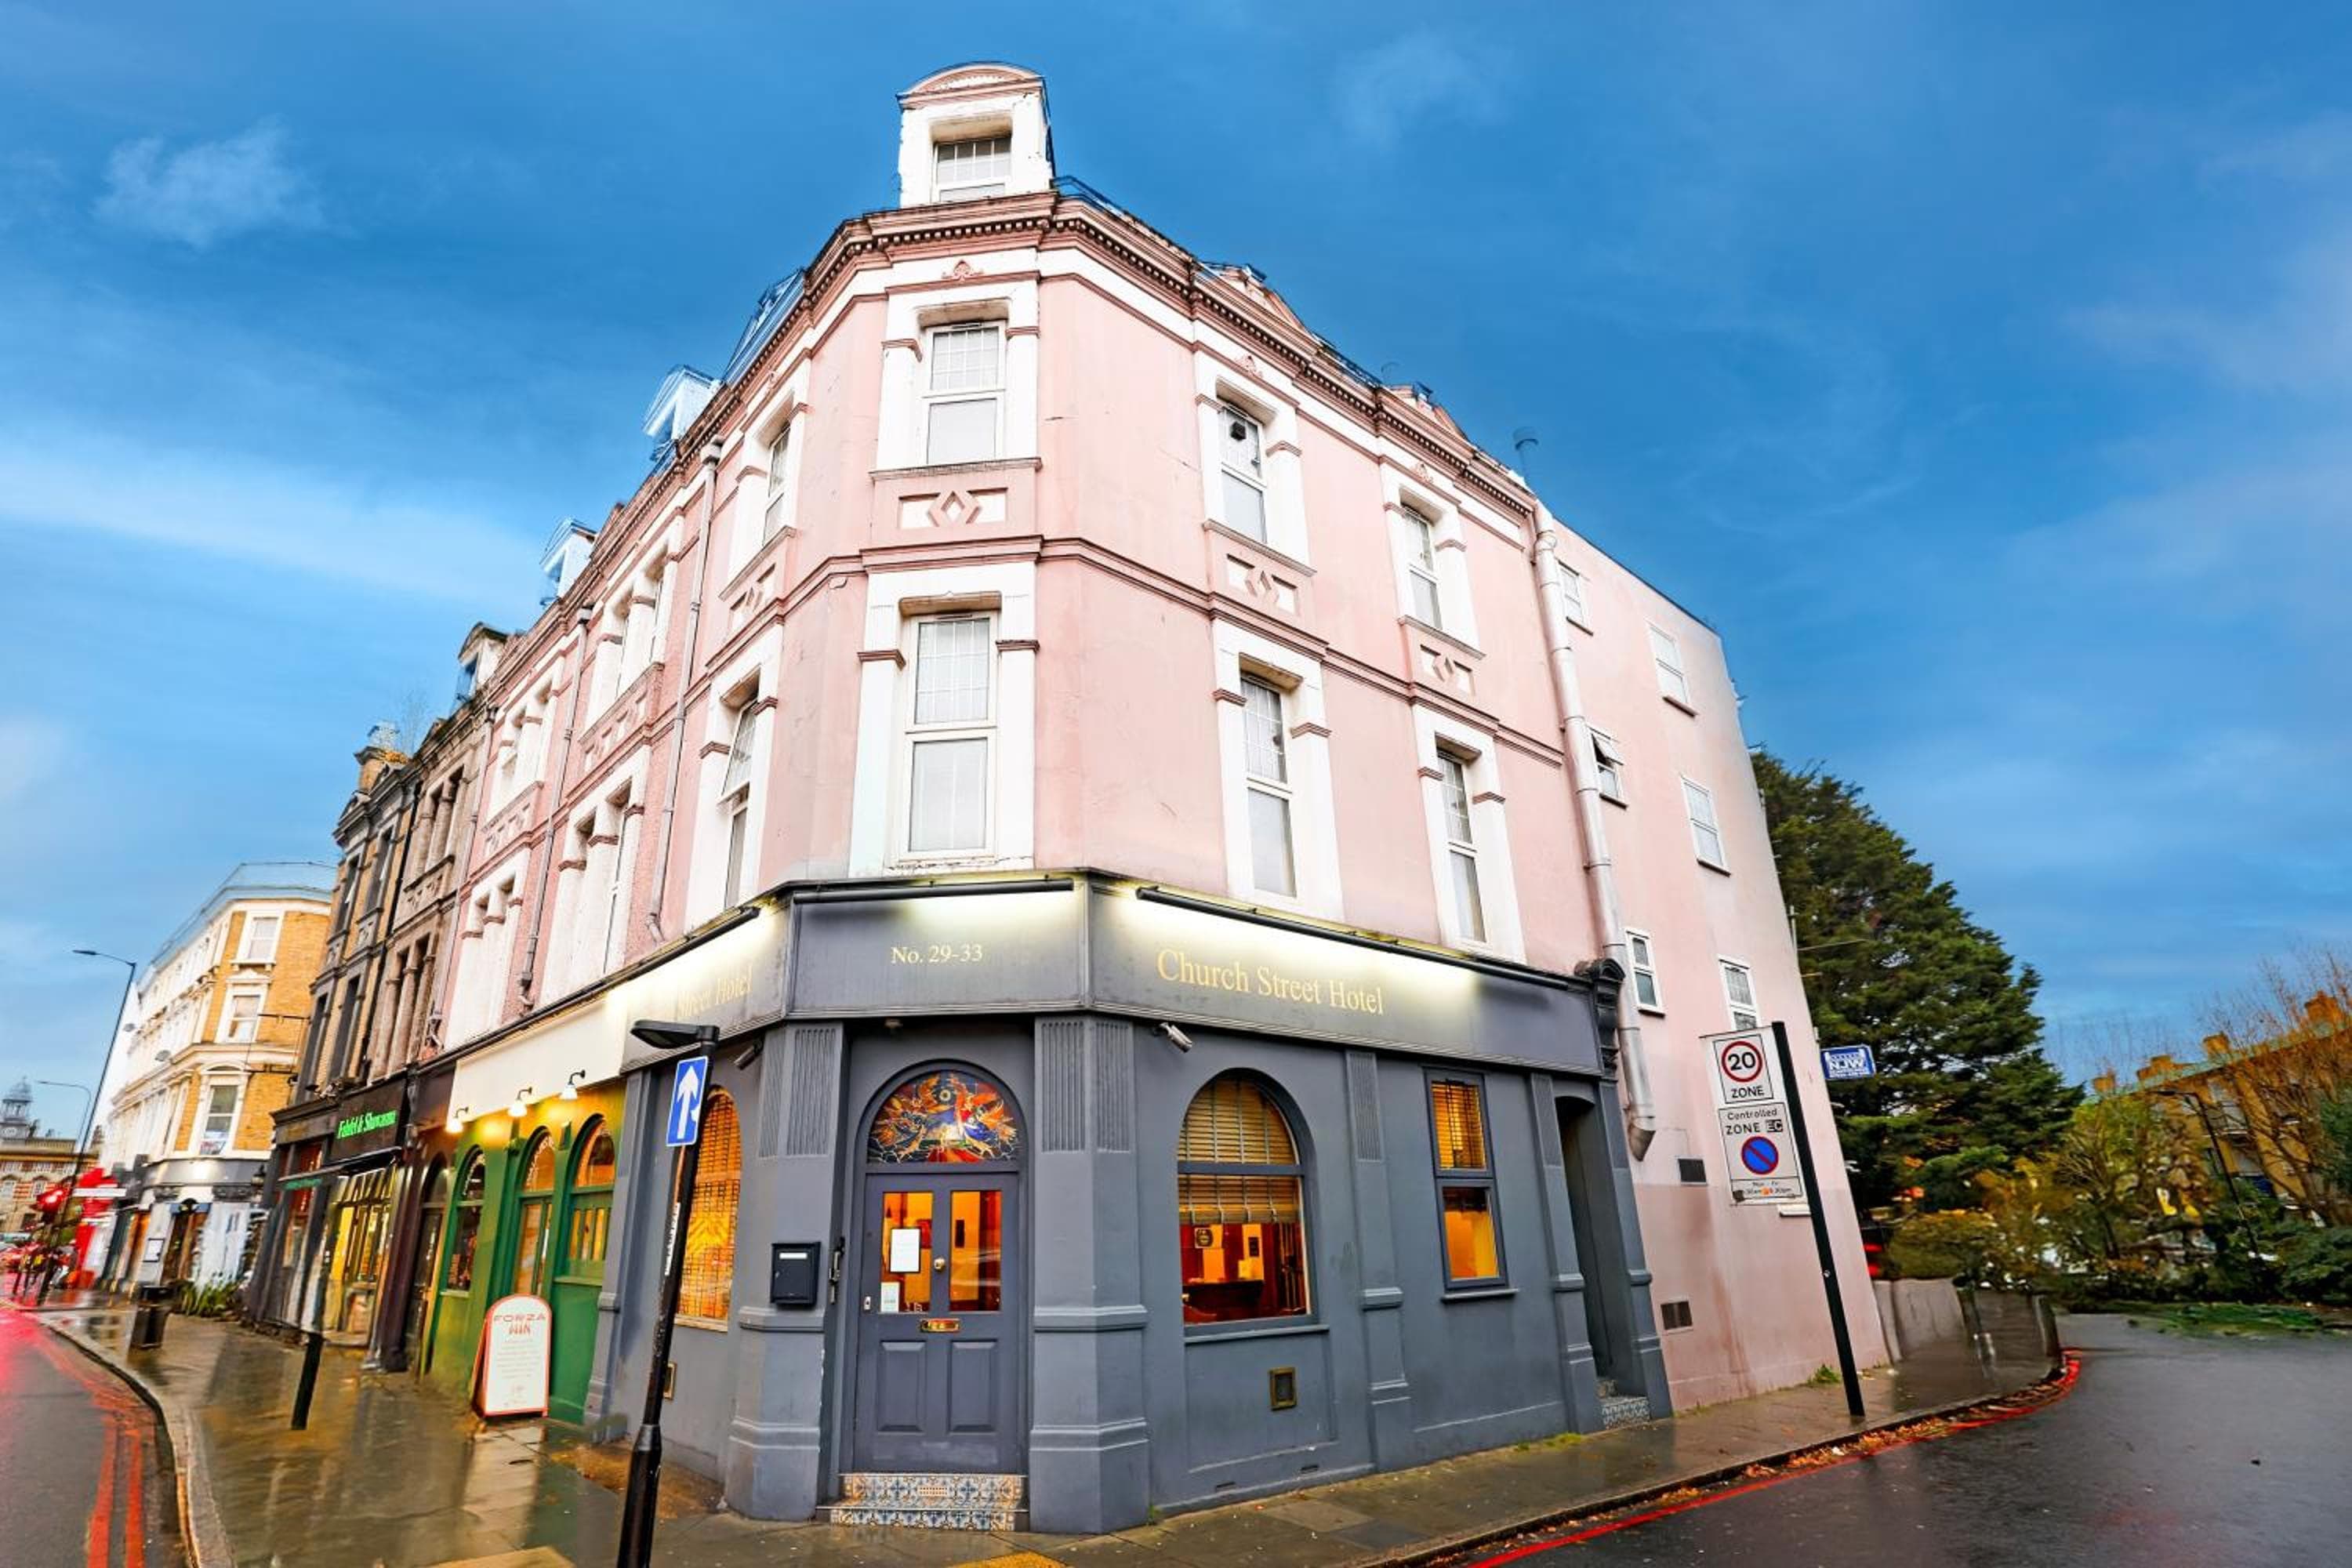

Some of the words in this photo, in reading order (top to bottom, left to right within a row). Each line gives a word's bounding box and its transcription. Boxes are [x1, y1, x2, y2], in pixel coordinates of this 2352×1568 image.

[891, 946, 923, 964] No.
[928, 943, 982, 963] 29-33
[714, 965, 753, 1004] Hotel
[1156, 949, 1250, 992] Church
[1257, 965, 1321, 1004] Street
[1328, 978, 1384, 1014] Hotel
[1727, 1051, 1757, 1071] 20
[1829, 1058, 1864, 1071] NJW
[1731, 1085, 1765, 1098] ZONE
[1727, 1109, 1777, 1120] Controlled
[1726, 1122, 1761, 1135] ZONE
